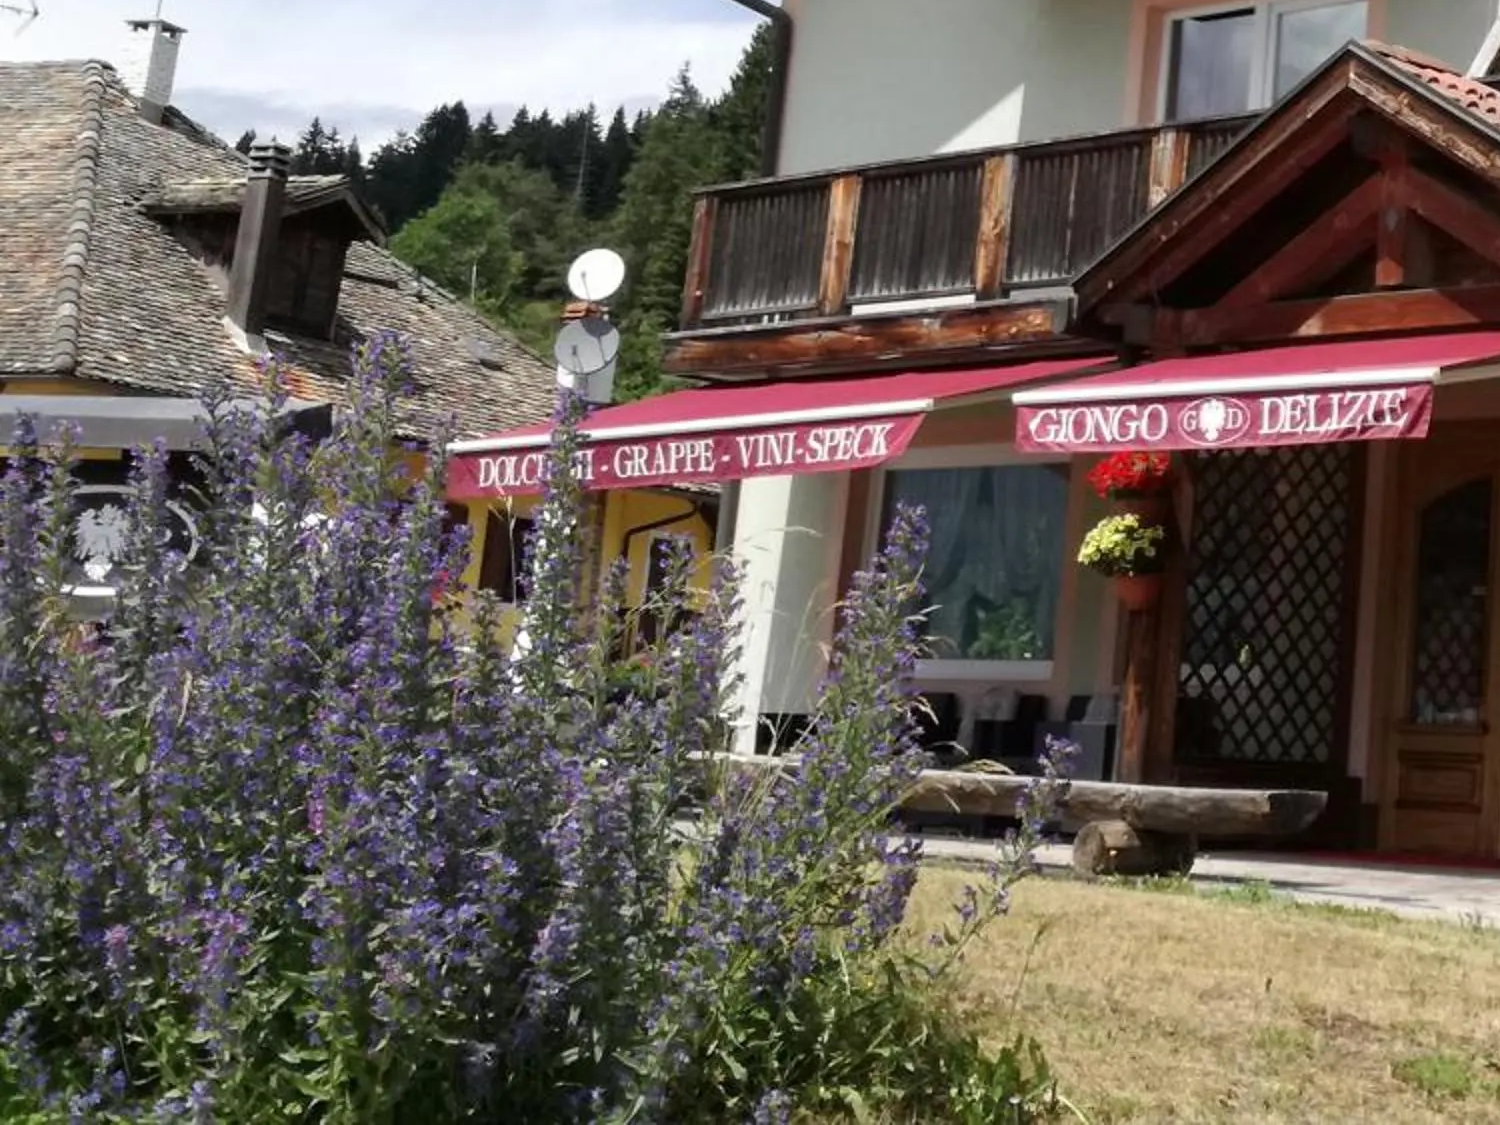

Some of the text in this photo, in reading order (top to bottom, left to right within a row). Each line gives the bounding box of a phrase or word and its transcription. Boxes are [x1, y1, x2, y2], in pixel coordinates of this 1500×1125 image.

[1029, 388, 1408, 444] GIONGO DELIZIE
[1183, 408, 1243, 432] G D
[613, 438, 717, 478] GRAPPE
